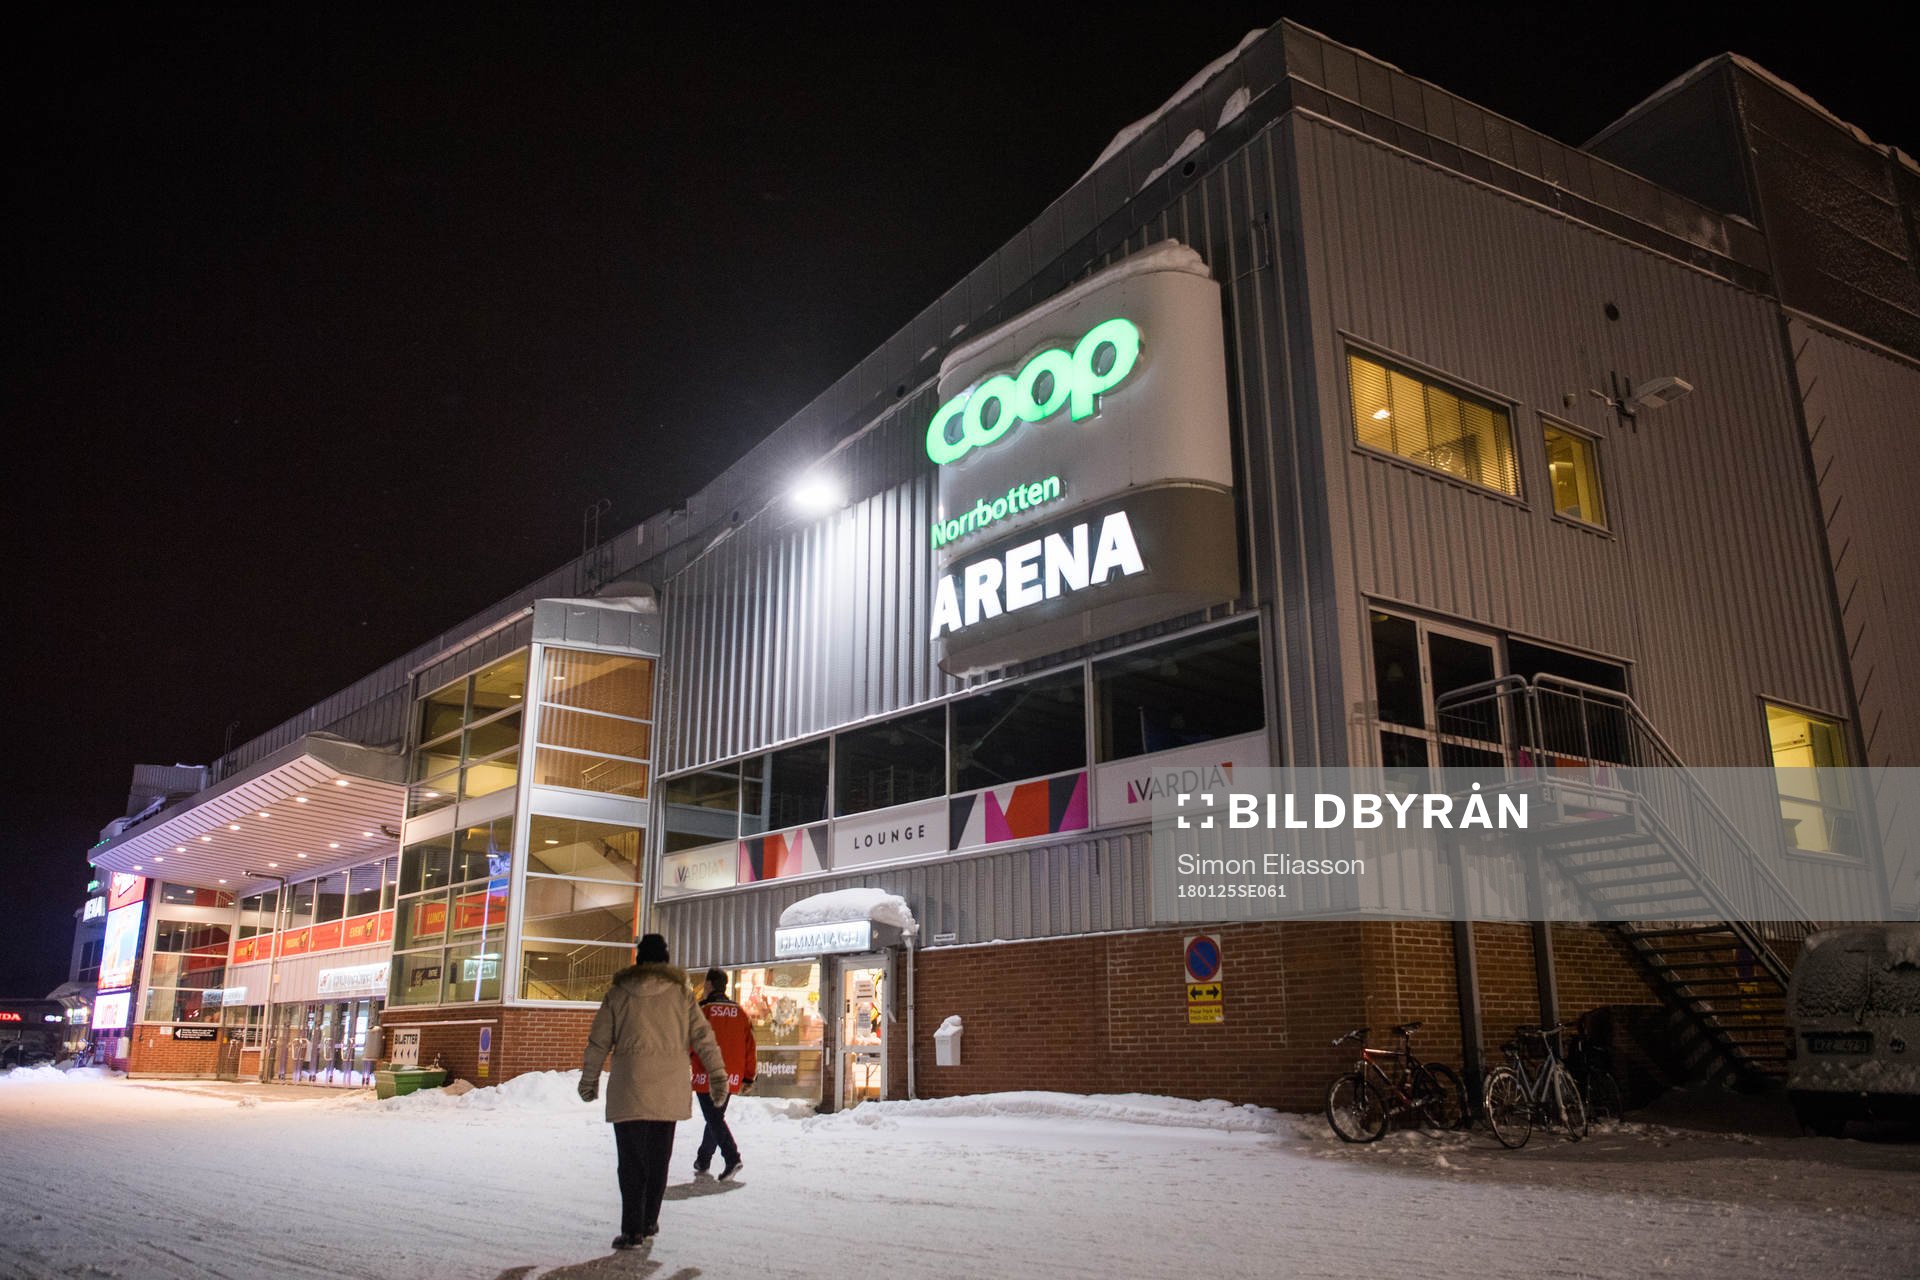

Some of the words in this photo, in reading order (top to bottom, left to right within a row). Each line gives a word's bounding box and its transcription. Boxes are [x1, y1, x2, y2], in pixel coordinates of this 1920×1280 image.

[926, 317, 1141, 465] coop
[931, 475, 1061, 549] Norrbotten
[930, 510, 1145, 641] ARENA
[1135, 764, 1226, 801] VARDIA
[854, 824, 925, 849] LOUNGE
[711, 1005, 738, 1017] SSAB
[394, 1033, 418, 1045] BILJETTER
[757, 1061, 797, 1078] Biljetter
